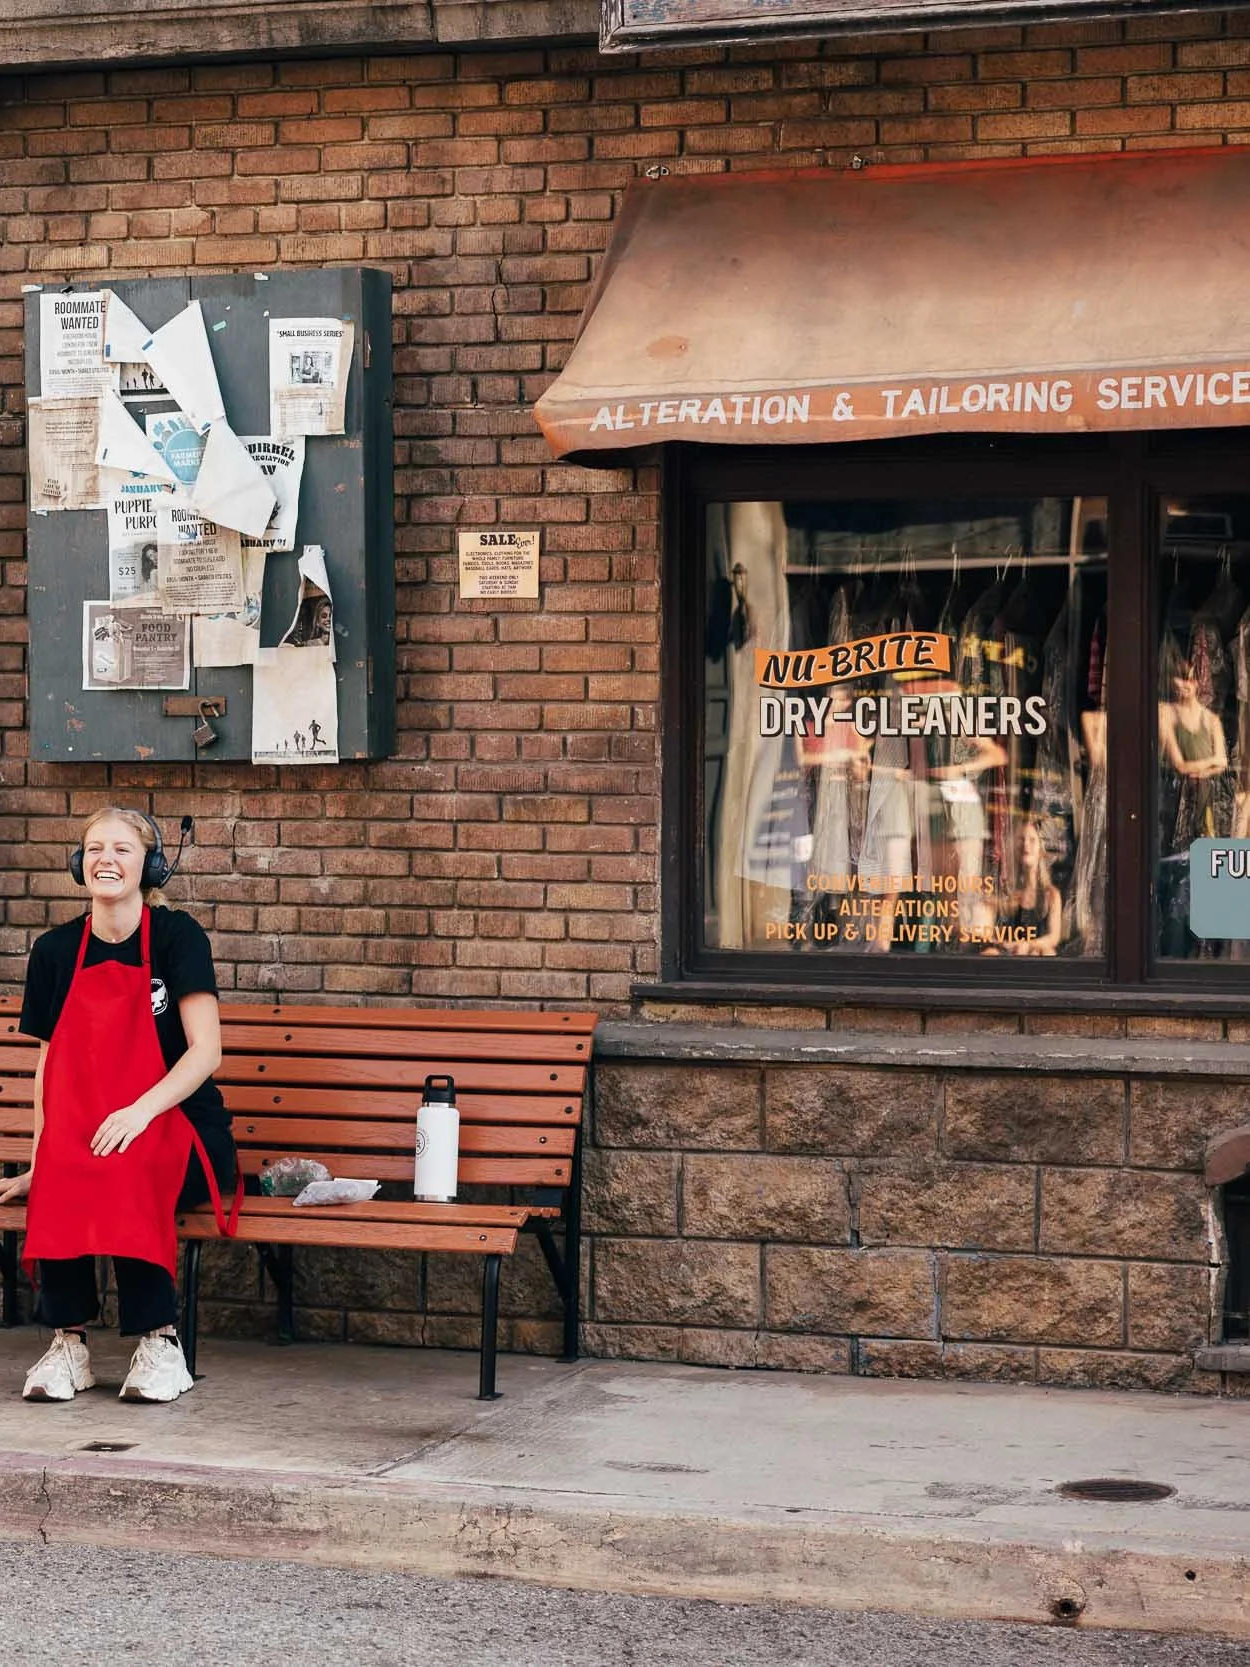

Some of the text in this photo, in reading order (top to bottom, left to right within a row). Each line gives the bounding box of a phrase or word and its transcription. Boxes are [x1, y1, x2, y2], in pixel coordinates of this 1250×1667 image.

[54, 300, 106, 315] ROOMMATE
[61, 316, 99, 330] WANTED
[589, 394, 810, 432] ALTERATION
[832, 392, 855, 422] &
[881, 380, 1073, 418] TAILORING
[244, 442, 295, 461] UIRREL
[114, 499, 152, 514] PUPPIE
[480, 534, 516, 546] SALE
[135, 633, 178, 642] PANTRY
[141, 623, 171, 633] FOOD
[762, 635, 937, 684] NU-BRITE
[759, 696, 1047, 737] DRY-CLEANERS
[1211, 849, 1250, 878] FU
[806, 874, 994, 894] CONVENIENT HOURS
[839, 899, 959, 918] ALTERATIONS
[765, 922, 1037, 944] PICK UP & DELIVERY SERVICE
